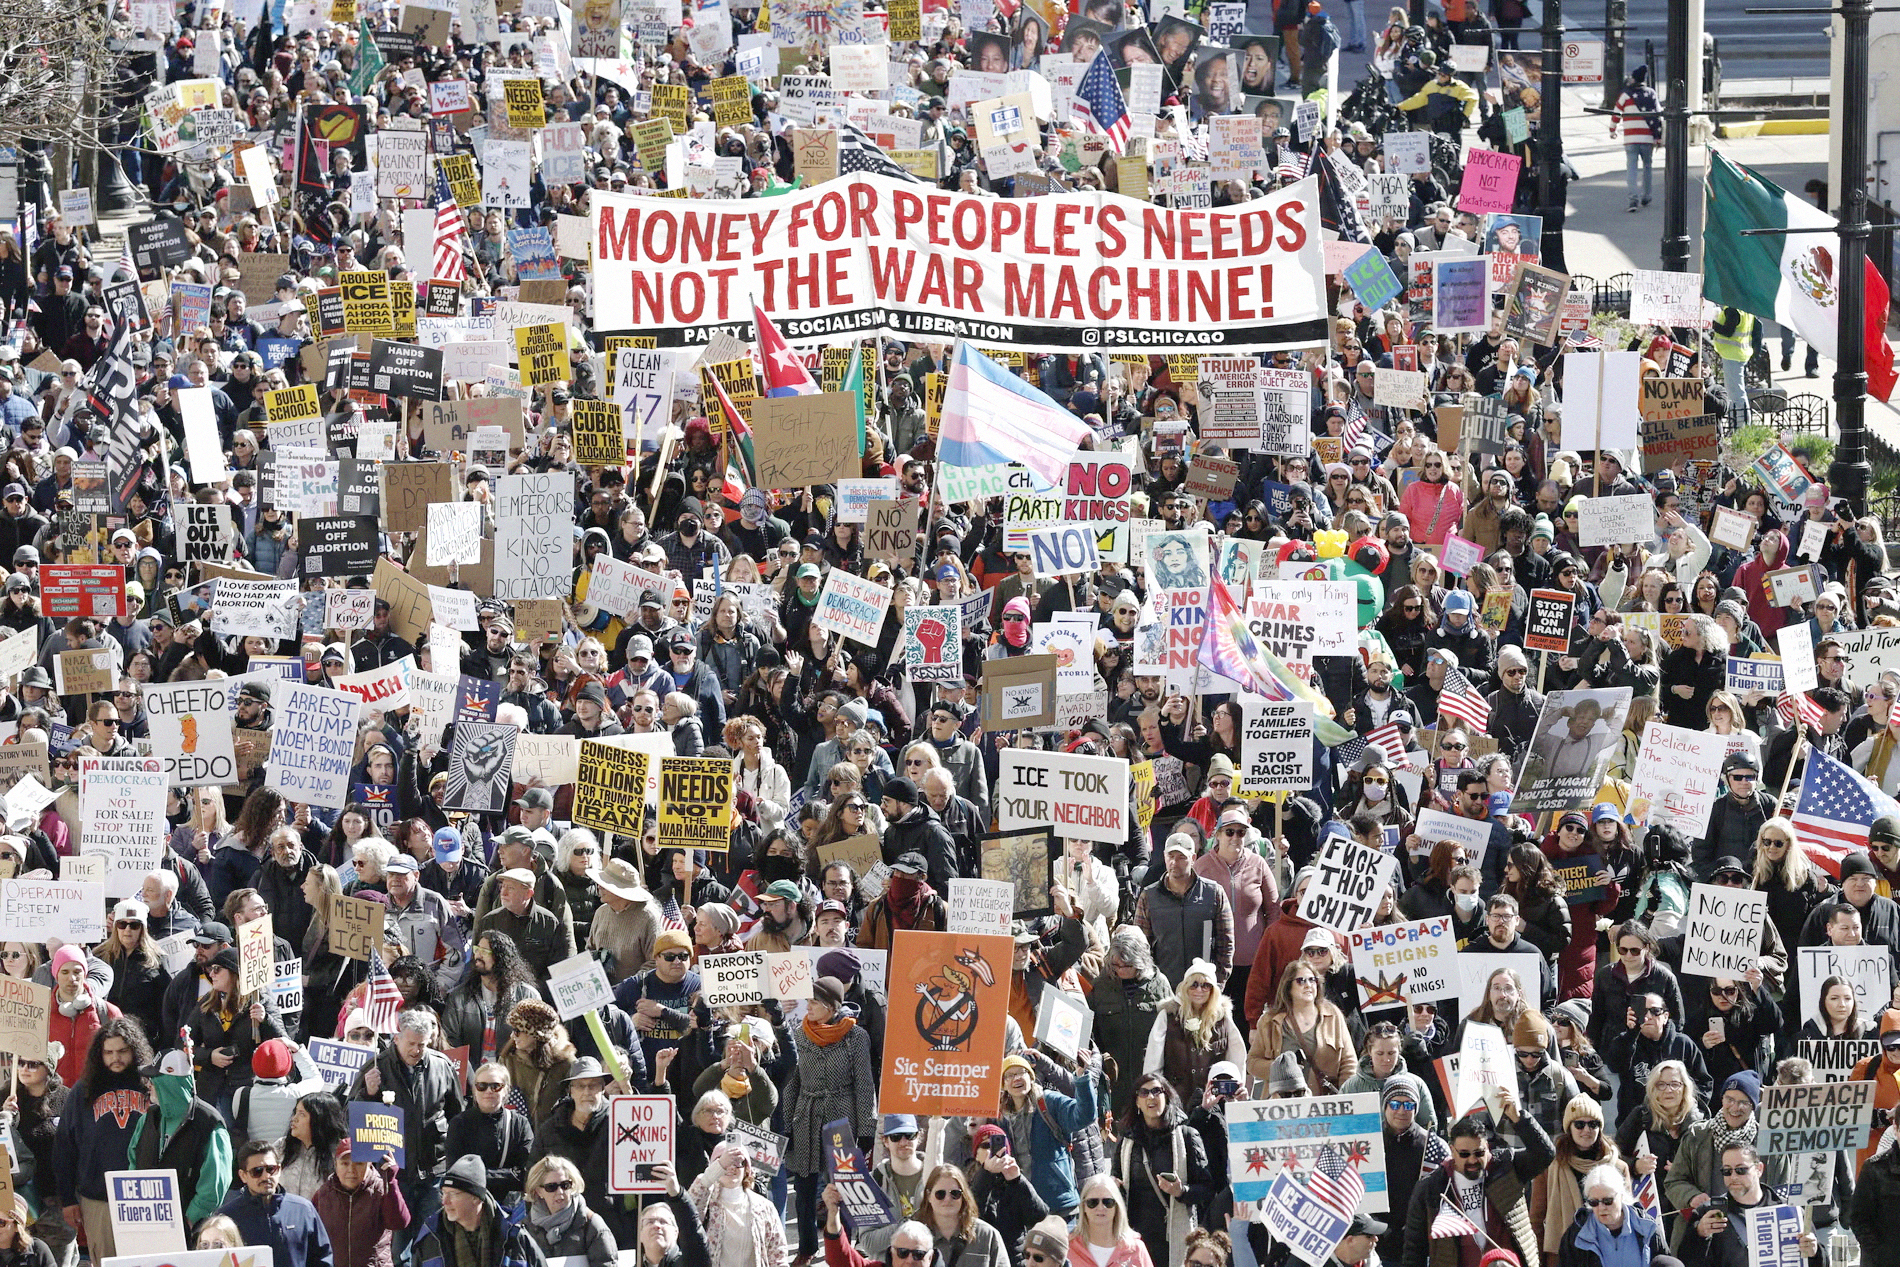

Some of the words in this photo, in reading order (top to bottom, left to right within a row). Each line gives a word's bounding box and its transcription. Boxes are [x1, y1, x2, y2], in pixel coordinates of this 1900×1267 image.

[772, 23, 795, 44] TRANS
[839, 27, 862, 44] KIDS
[787, 89, 804, 97] NO
[809, 90, 837, 98] WAR!
[378, 137, 427, 150] VETERANS
[379, 154, 424, 169] AGAINST
[803, 158, 829, 166] KINGS
[806, 150, 825, 158] NO
[1468, 151, 1521, 172] DEMOCRACY
[379, 171, 425, 186] FASCISM
[1480, 174, 1500, 187] NOT
[600, 206, 780, 263] MONEY
[787, 183, 880, 247] FOR
[894, 189, 1126, 258] PEOPLE'S
[1143, 200, 1307, 261] NEEDS
[340, 274, 386, 284] ABOLISH
[631, 267, 739, 324] NOT
[753, 248, 854, 312] THE
[868, 245, 985, 312] WAR
[1003, 263, 1274, 322] MACHINE!
[343, 286, 388, 299] ICE
[346, 310, 389, 318] AHORA
[430, 306, 454, 314] IRAN!
[529, 325, 549, 335] FUND
[684, 325, 743, 343] PARTY
[788, 310, 887, 336] SOCIALISM
[888, 312, 901, 329] &
[905, 314, 1014, 341] LIBERATION
[527, 334, 554, 345] PUBLIC
[1104, 330, 1225, 344] PSLCHICAGO
[388, 346, 424, 357] HANDS
[521, 342, 562, 356] EDUCATION
[396, 358, 415, 366] OFF
[533, 355, 554, 369] NOT
[622, 353, 660, 371] CLEAN
[1202, 360, 1255, 372] TRUMP
[379, 366, 433, 379] ABORTION
[530, 367, 560, 384] WAR!
[622, 372, 655, 389] AISLE
[1214, 373, 1257, 381] AMERICA'S
[1226, 379, 1254, 388] ERROR
[1645, 381, 1668, 399] NO
[1671, 381, 1703, 401] WAR
[275, 389, 306, 406] BUILD
[1264, 392, 1283, 402] VOTE
[269, 401, 318, 421] SCHOOLS
[573, 401, 586, 411] NO
[589, 402, 608, 413] WAR
[609, 404, 620, 414] ON
[1264, 403, 1286, 413] TOTAL
[575, 412, 621, 433] CUBA!
[1265, 412, 1303, 424] LANDSLIDE
[269, 421, 323, 439] PROTECT
[576, 433, 597, 445] END
[601, 435, 621, 446] THE
[577, 444, 624, 459] BLOCKADE!
[521, 476, 550, 494] NO
[1068, 463, 1131, 498] NO
[500, 494, 572, 517] EMPERORS
[1064, 500, 1129, 522] KINGS
[188, 507, 217, 524] ICE
[316, 520, 356, 530] HANDS
[521, 516, 551, 535] NO
[188, 525, 220, 542] OUT
[326, 532, 347, 541] OFF
[185, 543, 229, 560] NOW
[309, 542, 369, 554] ABORTION
[507, 536, 562, 558] KINGS
[1032, 527, 1098, 573] NO!
[521, 557, 550, 576] NO
[495, 576, 571, 599] DICTATORS
[1535, 600, 1568, 612] STOP
[1537, 609, 1565, 620] WAR
[1540, 617, 1559, 628] ON
[1532, 625, 1565, 638] IRAN!
[909, 664, 960, 680] RESIST!
[147, 690, 224, 714] CHEETO
[1261, 707, 1295, 716] KEEP
[1250, 717, 1306, 728] FAMILIES
[1246, 729, 1311, 739] TOGETHER
[582, 741, 647, 767] CONGRESS:
[1258, 752, 1296, 763] STOP
[165, 756, 232, 781] PEDO
[1251, 763, 1302, 776] RACIST
[88, 773, 164, 785] DEMOCRACY
[578, 765, 644, 794] BILLIONS
[1013, 766, 1048, 787] ICE
[1059, 770, 1109, 794] TOOK
[1244, 775, 1310, 785] DEPORTATION
[663, 774, 728, 802] NEEDS
[96, 810, 118, 820] FOR
[122, 810, 154, 820] SALE!
[576, 804, 638, 829] IRAN
[667, 803, 723, 817] NOT
[1004, 797, 1049, 820] YOUR
[1054, 802, 1121, 830] NEIGHBOR
[94, 822, 123, 832] STOP
[129, 822, 153, 833] THE
[660, 823, 682, 837] WAR
[686, 824, 727, 839] MACHINE
[82, 834, 157, 846] BILLIONAIRE
[1324, 838, 1383, 874] FUCK
[1320, 865, 1375, 900] THIS
[6, 883, 82, 901] OPERATION
[6, 902, 59, 915] EPSTEIN
[334, 902, 374, 921] MELT
[1306, 895, 1374, 931] SHIT!
[1700, 894, 1726, 917] NO
[1734, 903, 1761, 924] ICE
[6, 914, 45, 928] FILES
[345, 921, 362, 932] THE
[1352, 918, 1449, 950] DEMOCRACY
[1691, 921, 1715, 942] NO
[1721, 930, 1757, 951] WAR
[244, 941, 270, 962] REAL
[335, 931, 372, 956] ICE
[704, 952, 763, 969] BARRON'S
[1373, 945, 1439, 967] REIGNS
[1687, 947, 1708, 966] NO
[247, 956, 268, 974] EPIC
[1414, 967, 1427, 977] NO
[246, 970, 269, 993] FURY
[717, 969, 758, 982] BOOTS
[1410, 979, 1445, 994] KINGS!
[709, 991, 763, 1005] GROUND
[894, 1057, 918, 1076] Sic
[923, 1059, 990, 1085] Semper
[905, 1078, 979, 1102] Tyrannis
[1768, 1084, 1868, 1109] IMPEACH
[632, 1106, 653, 1121] NO
[1253, 1105, 1300, 1121] YOU
[1307, 1101, 1354, 1117] ARE
[1767, 1105, 1863, 1129] CONVICT
[1277, 1123, 1332, 1139] NOW
[1770, 1128, 1858, 1152] REMOVE
[630, 1150, 656, 1162] ANY
[121, 1180, 138, 1198] ICE
[142, 1178, 164, 1197] OUT!
[835, 1181, 876, 1205] NO
[154, 1203, 173, 1221] ICE!
[847, 1203, 885, 1216] KINGS
